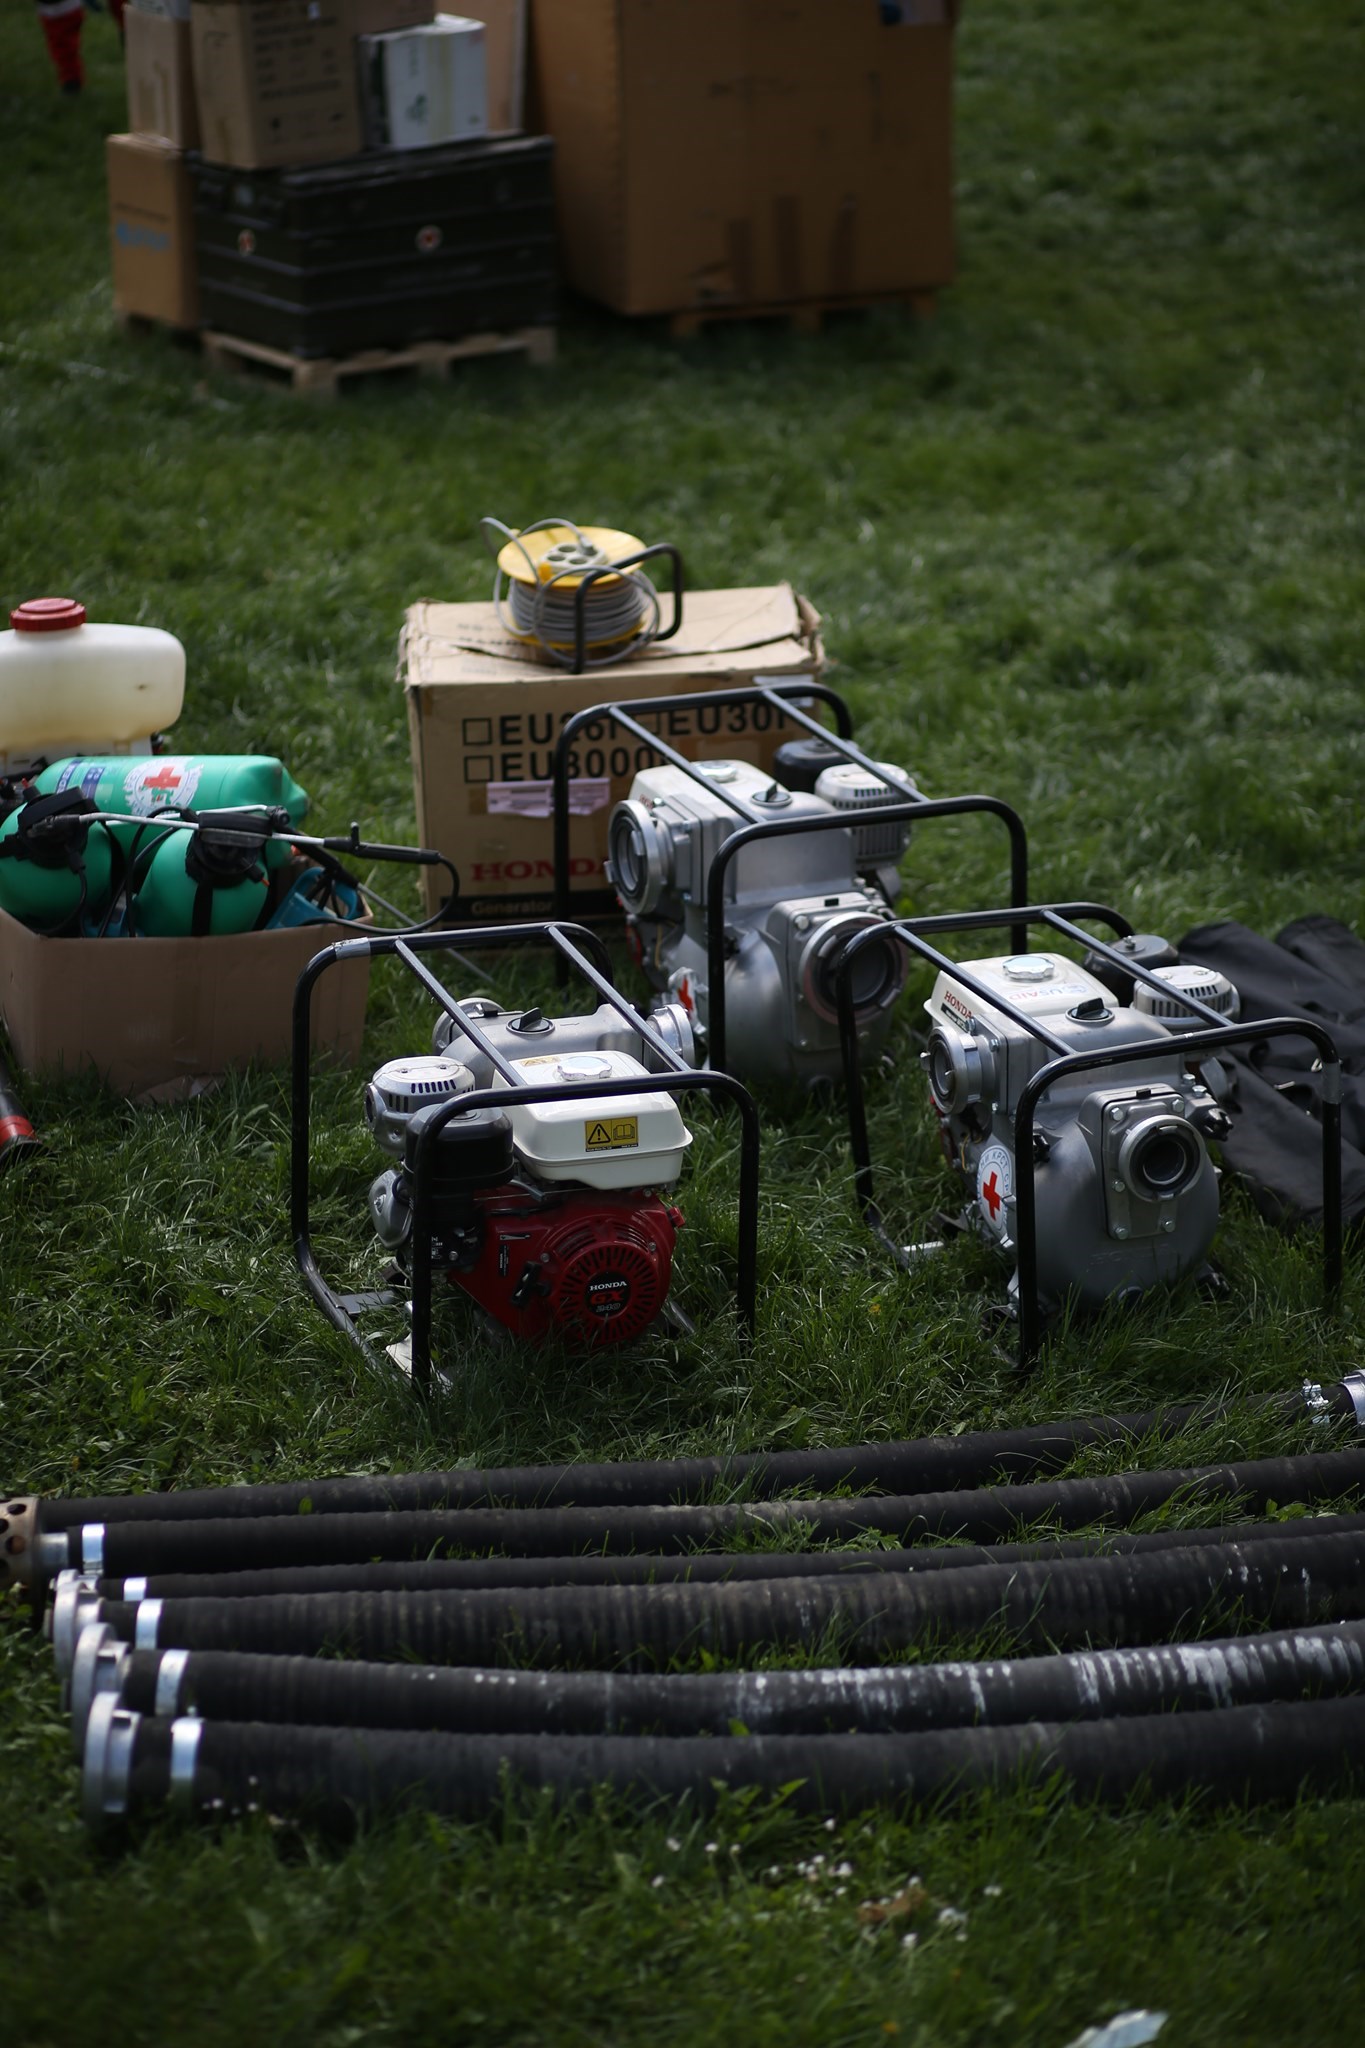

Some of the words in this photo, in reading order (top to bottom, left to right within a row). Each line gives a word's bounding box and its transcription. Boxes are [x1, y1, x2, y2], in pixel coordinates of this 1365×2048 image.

[471, 899, 553, 916] Generator
[1009, 987, 1064, 1001] USAID
[944, 990, 974, 1019] HONDA
[590, 1280, 627, 1291] HONDA
[591, 1290, 625, 1305] GX
